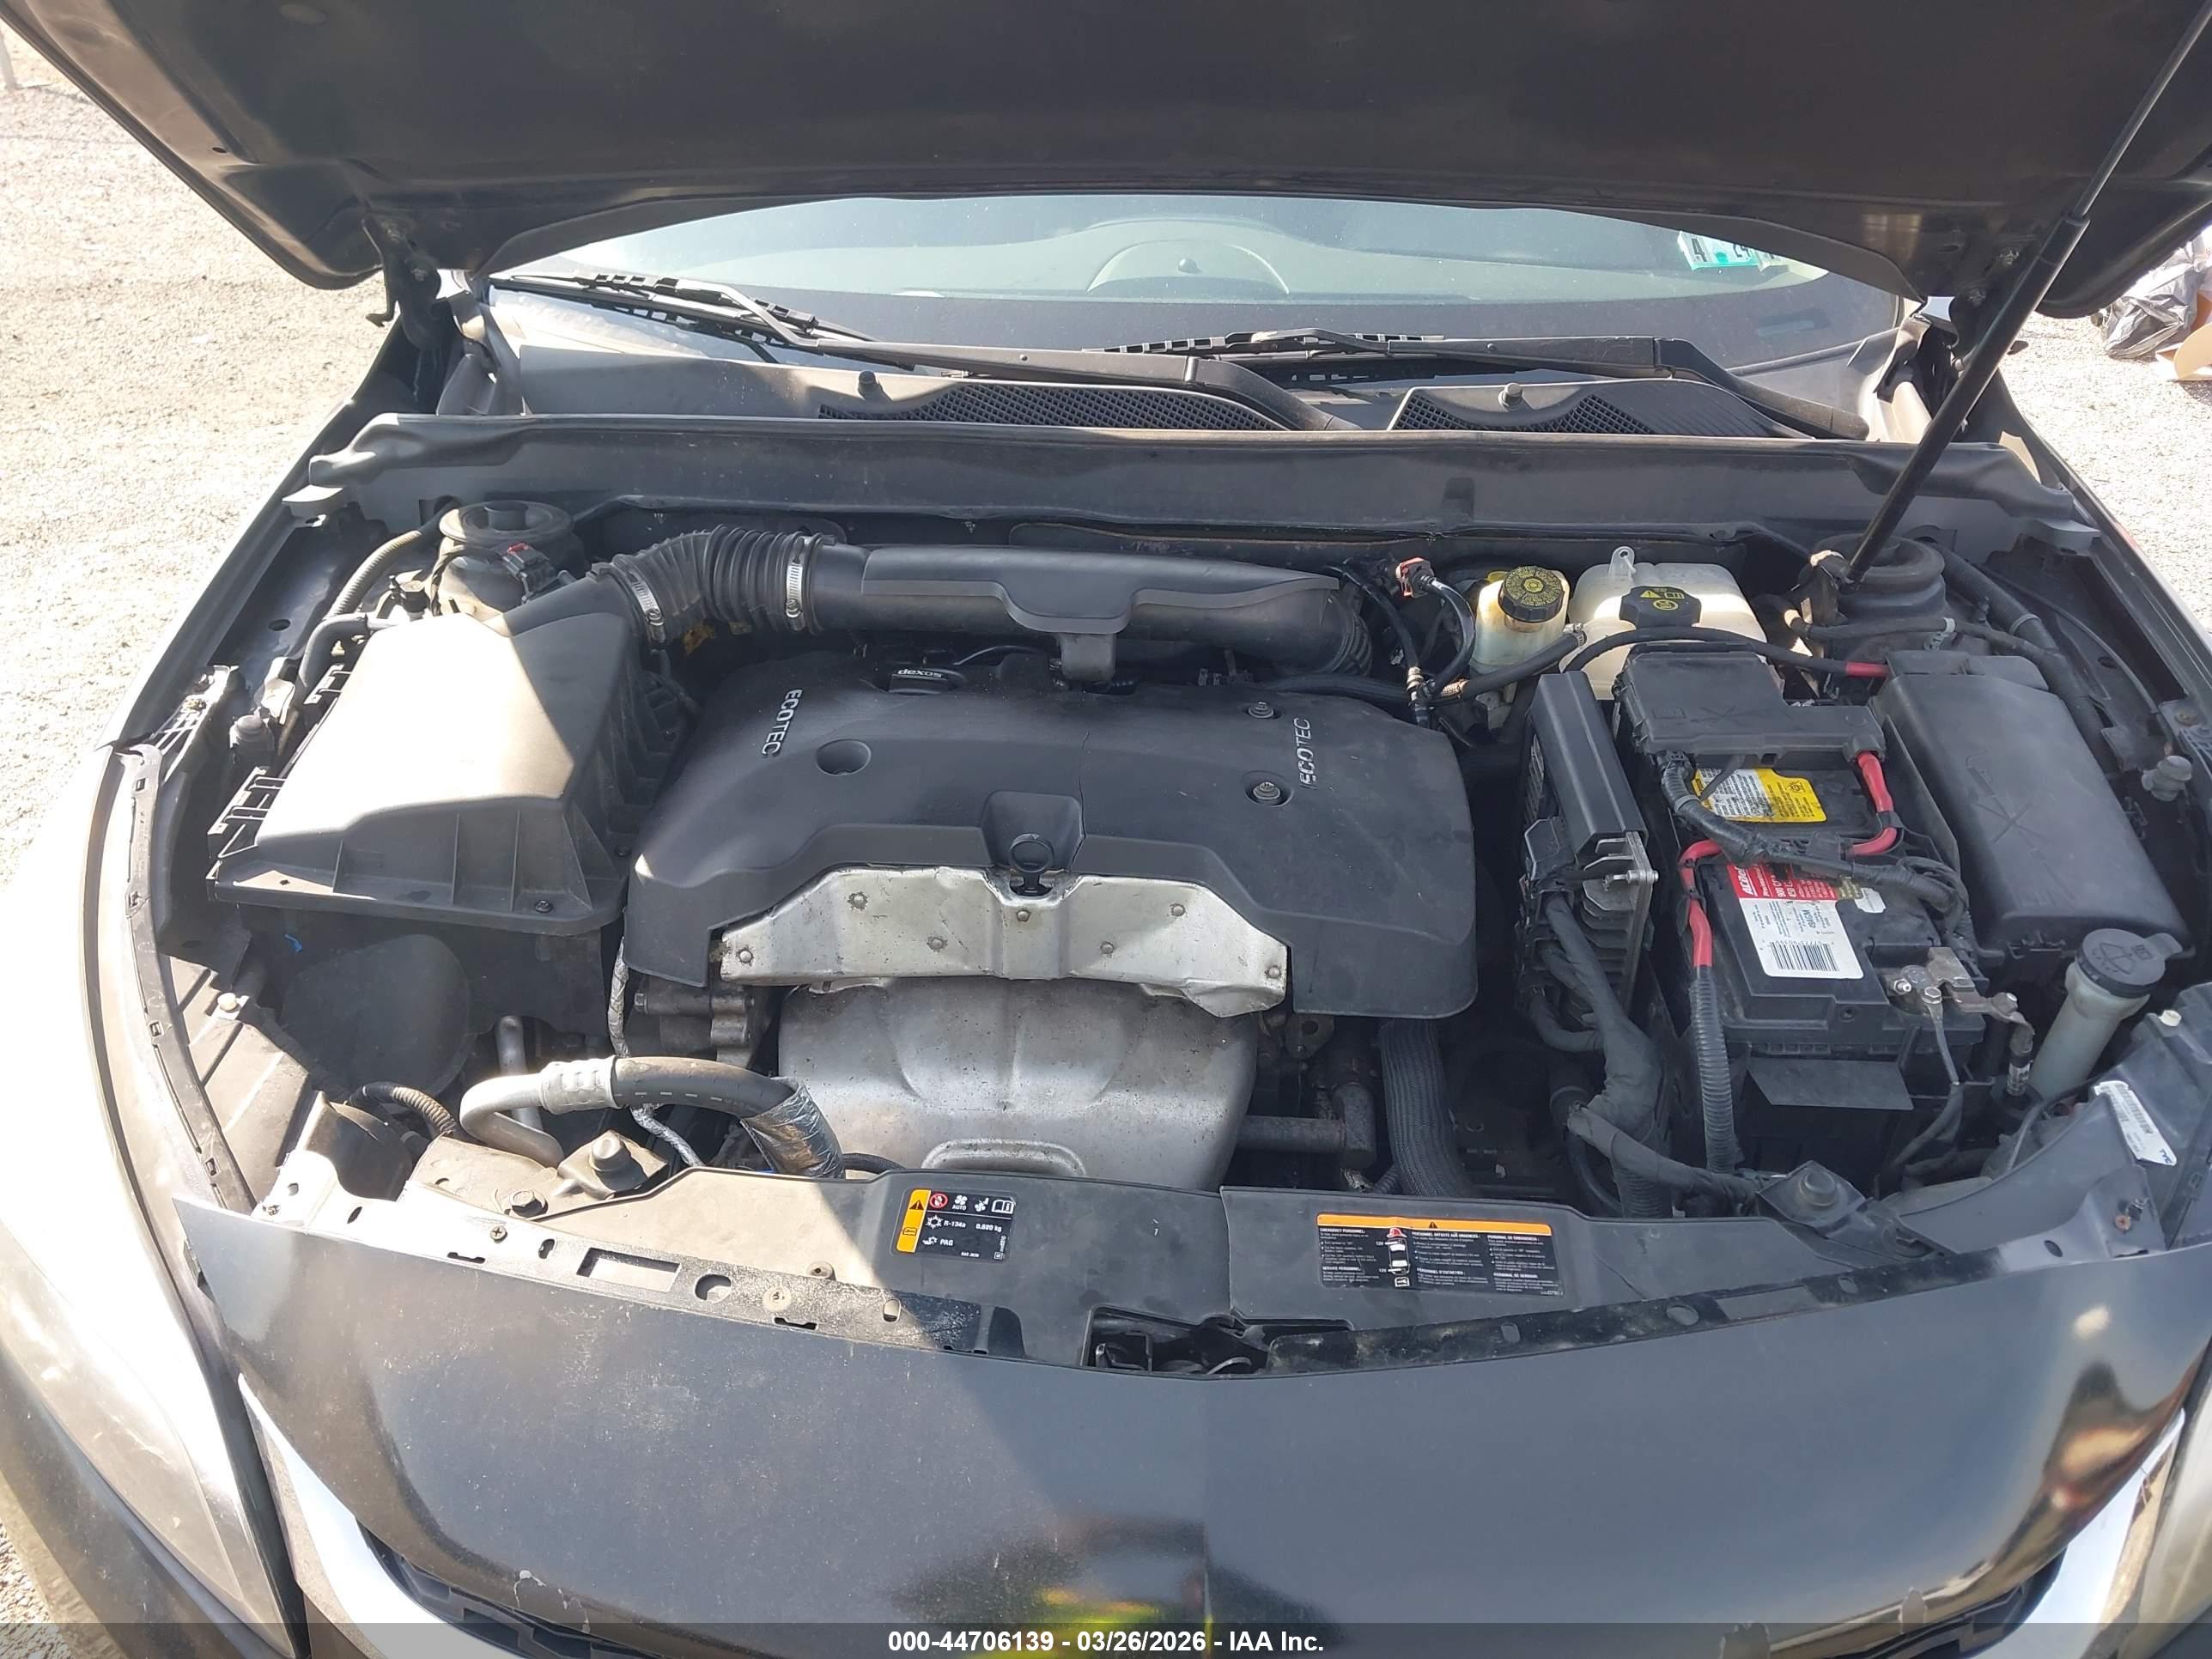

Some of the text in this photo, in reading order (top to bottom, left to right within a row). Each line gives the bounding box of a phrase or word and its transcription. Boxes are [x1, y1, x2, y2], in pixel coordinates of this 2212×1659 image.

[897, 668, 943, 678] dexos
[762, 688, 804, 757] ECOTEC
[1293, 717, 1316, 787] ECOTEC
[944, 1219, 966, 1228] R-134a
[994, 1224, 1002, 1233] kg
